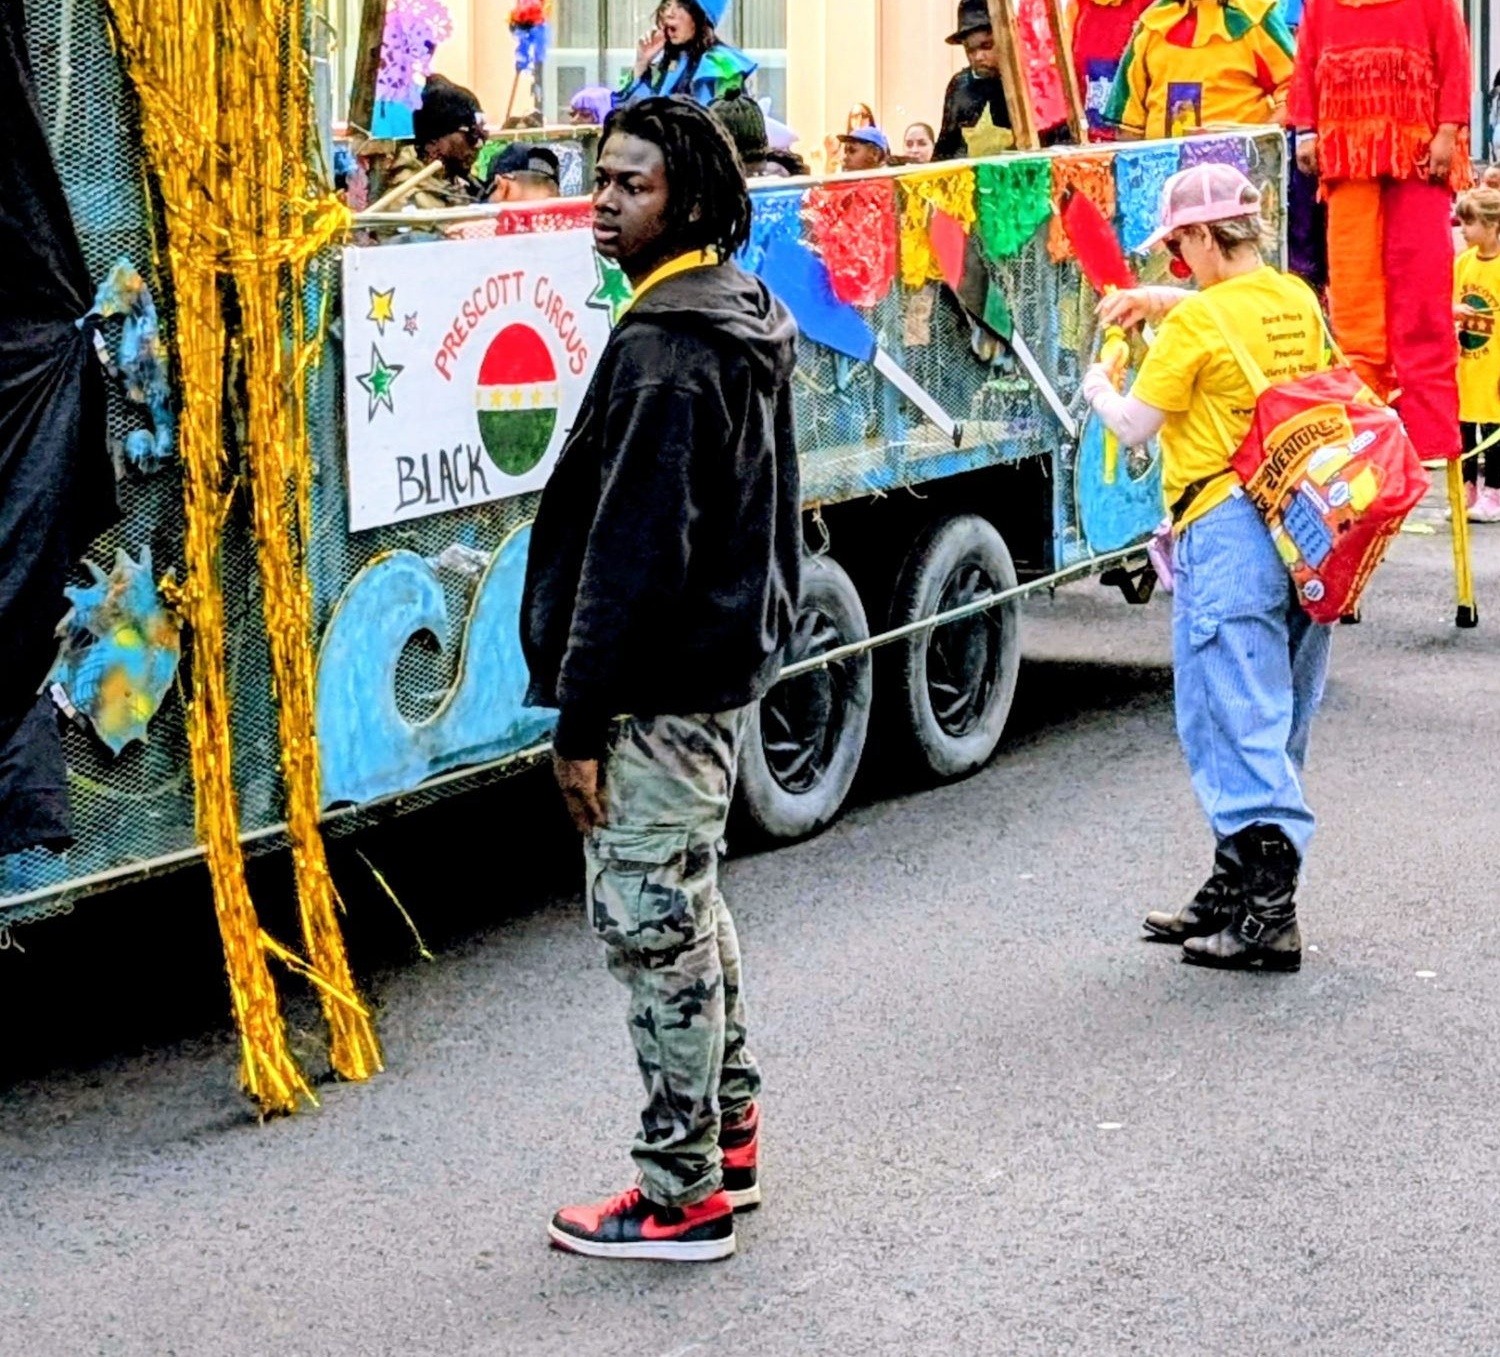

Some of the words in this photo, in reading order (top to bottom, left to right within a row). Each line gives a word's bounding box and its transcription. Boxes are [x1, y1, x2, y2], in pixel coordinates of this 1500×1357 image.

[434, 270, 525, 382] PRESCOTT
[533, 275, 589, 376] CIRCUS
[395, 443, 491, 513] BLACK
